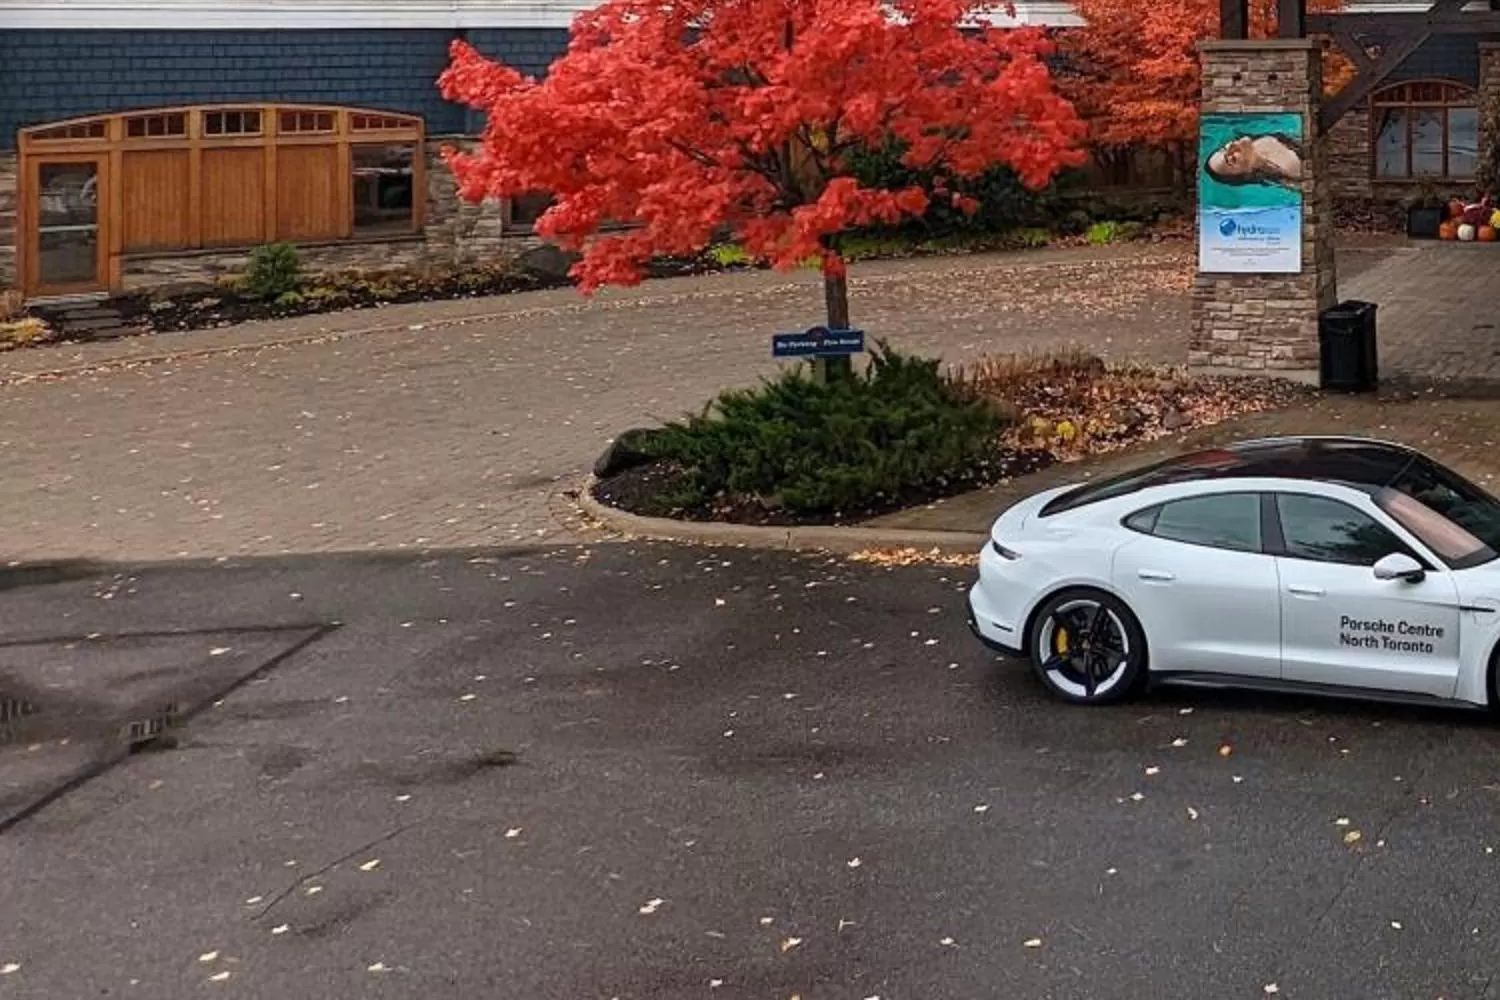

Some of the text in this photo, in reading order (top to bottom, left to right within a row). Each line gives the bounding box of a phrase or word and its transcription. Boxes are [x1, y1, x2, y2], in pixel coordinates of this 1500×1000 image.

[1341, 615, 1445, 638] Porsche Centre
[1340, 632, 1433, 653] North Toronto
